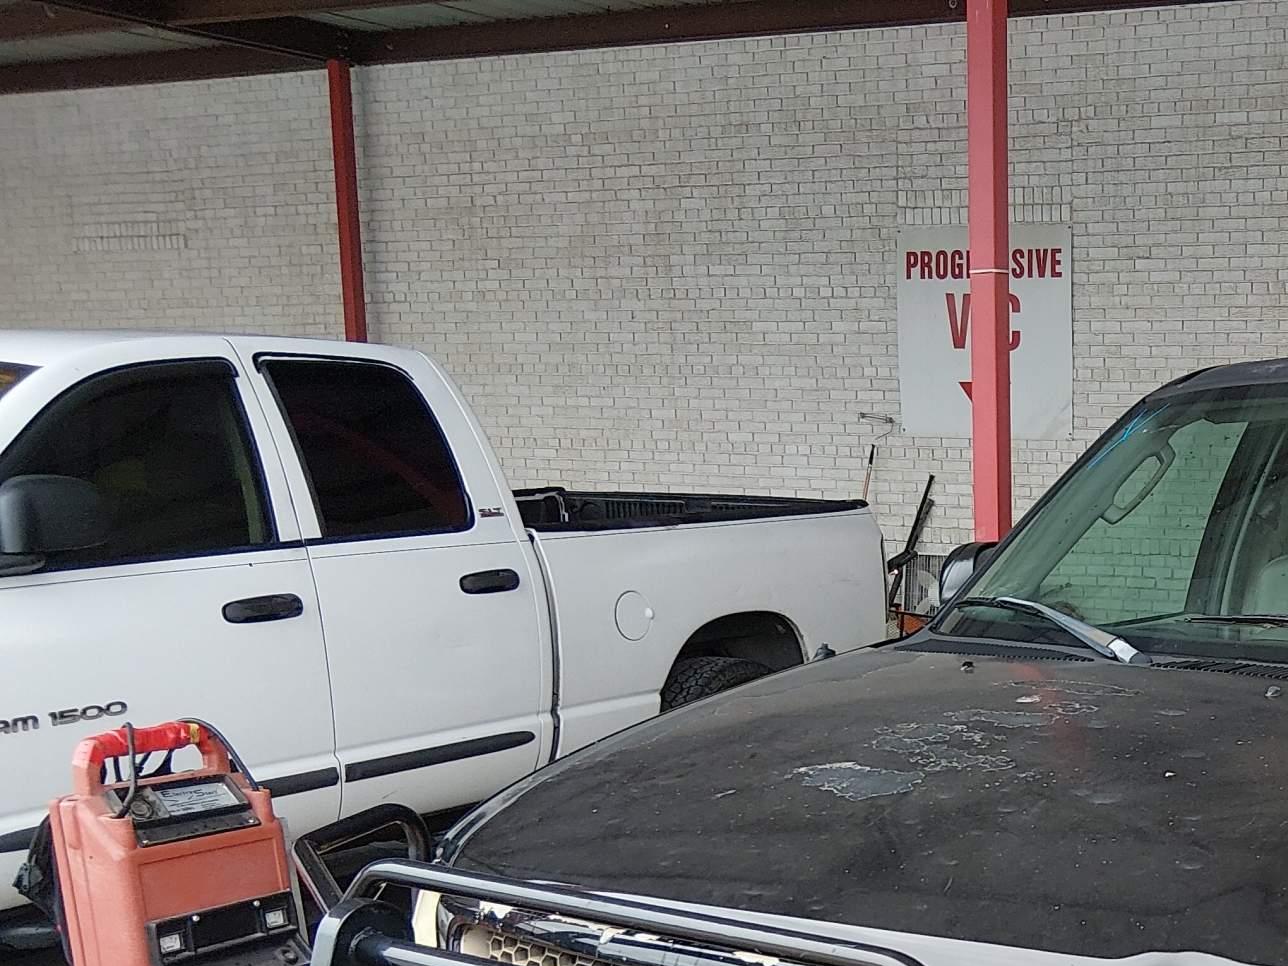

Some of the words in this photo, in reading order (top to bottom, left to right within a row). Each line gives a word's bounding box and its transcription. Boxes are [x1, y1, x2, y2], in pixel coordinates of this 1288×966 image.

[905, 248, 1063, 280] PROGSIVE
[945, 292, 1022, 351] VC
[48, 700, 128, 727] 1500
